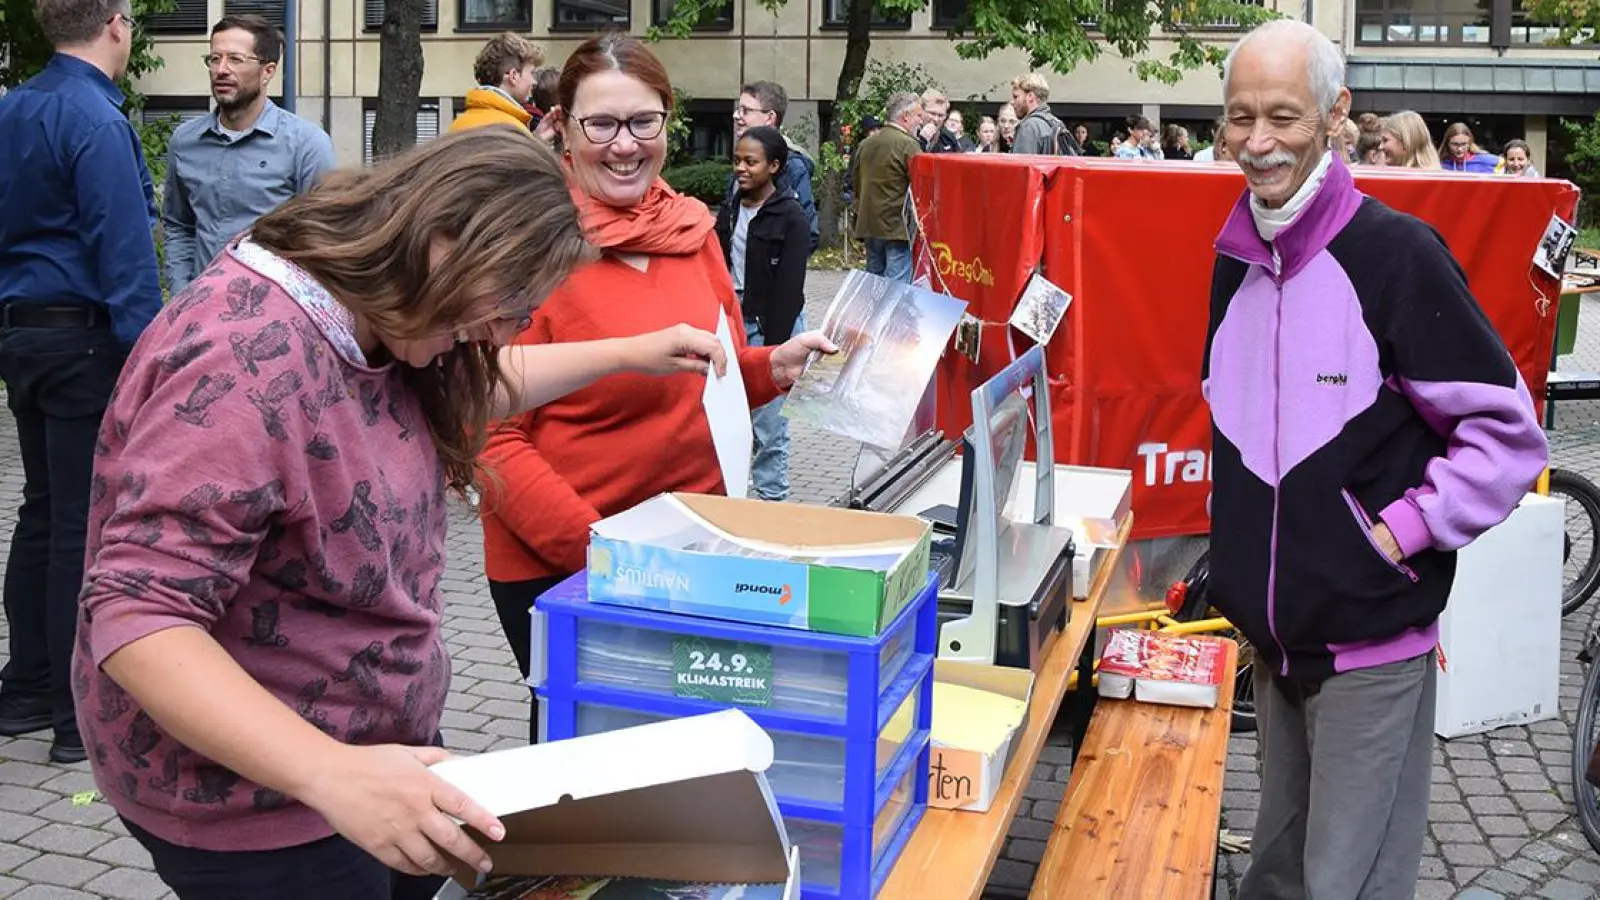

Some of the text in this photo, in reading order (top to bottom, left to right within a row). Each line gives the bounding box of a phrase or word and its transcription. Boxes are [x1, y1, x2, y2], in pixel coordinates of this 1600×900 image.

[1137, 442, 1212, 486] Tra
[616, 565, 690, 592] NAUTILUS
[735, 583, 783, 596] mondi
[689, 651, 754, 674] 24.9.
[677, 673, 767, 689] KLIMASTREIK
